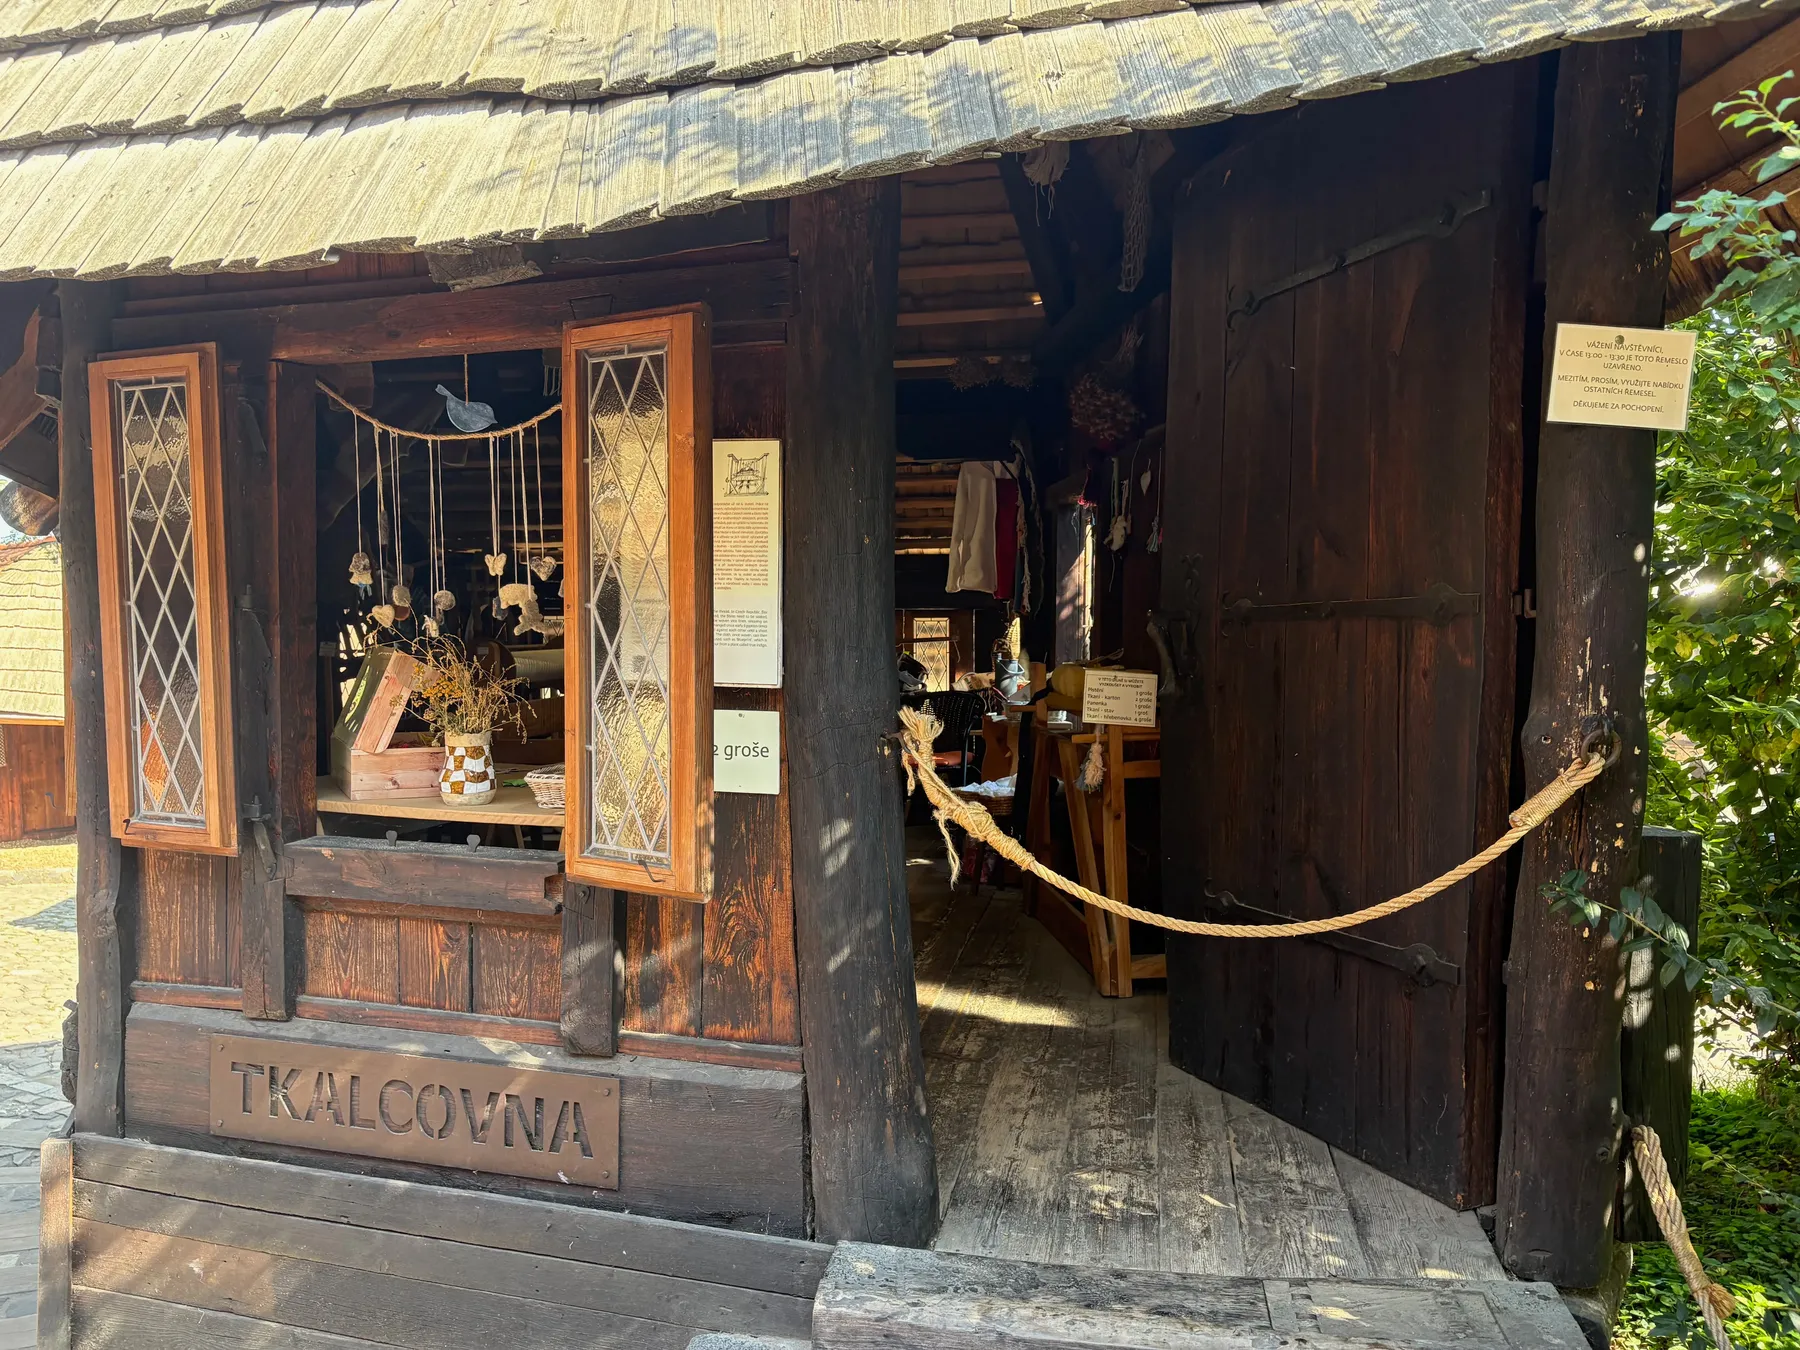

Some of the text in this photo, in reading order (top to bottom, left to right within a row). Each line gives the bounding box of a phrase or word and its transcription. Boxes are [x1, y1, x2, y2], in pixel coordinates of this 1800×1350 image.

[1586, 340, 1614, 350] VÁŽENÍ
[1566, 349, 1583, 357] ČASE
[1626, 354, 1633, 362] JE
[1656, 355, 1688, 365] ŘEMESLO
[1603, 362, 1642, 371] UZAVŘENO.
[1558, 374, 1683, 389] MEZITÍM, PROSÍM, VYUŽIJTE NABÍDKU
[1584, 386, 1656, 397] OSTATNÍCH ŘEMESEL.
[1573, 400, 1609, 409] DĚKUJEME
[1621, 404, 1664, 413] POCHOPENÍ.
[724, 742, 769, 760] groše
[231, 1061, 593, 1160] TKALCOVNA
